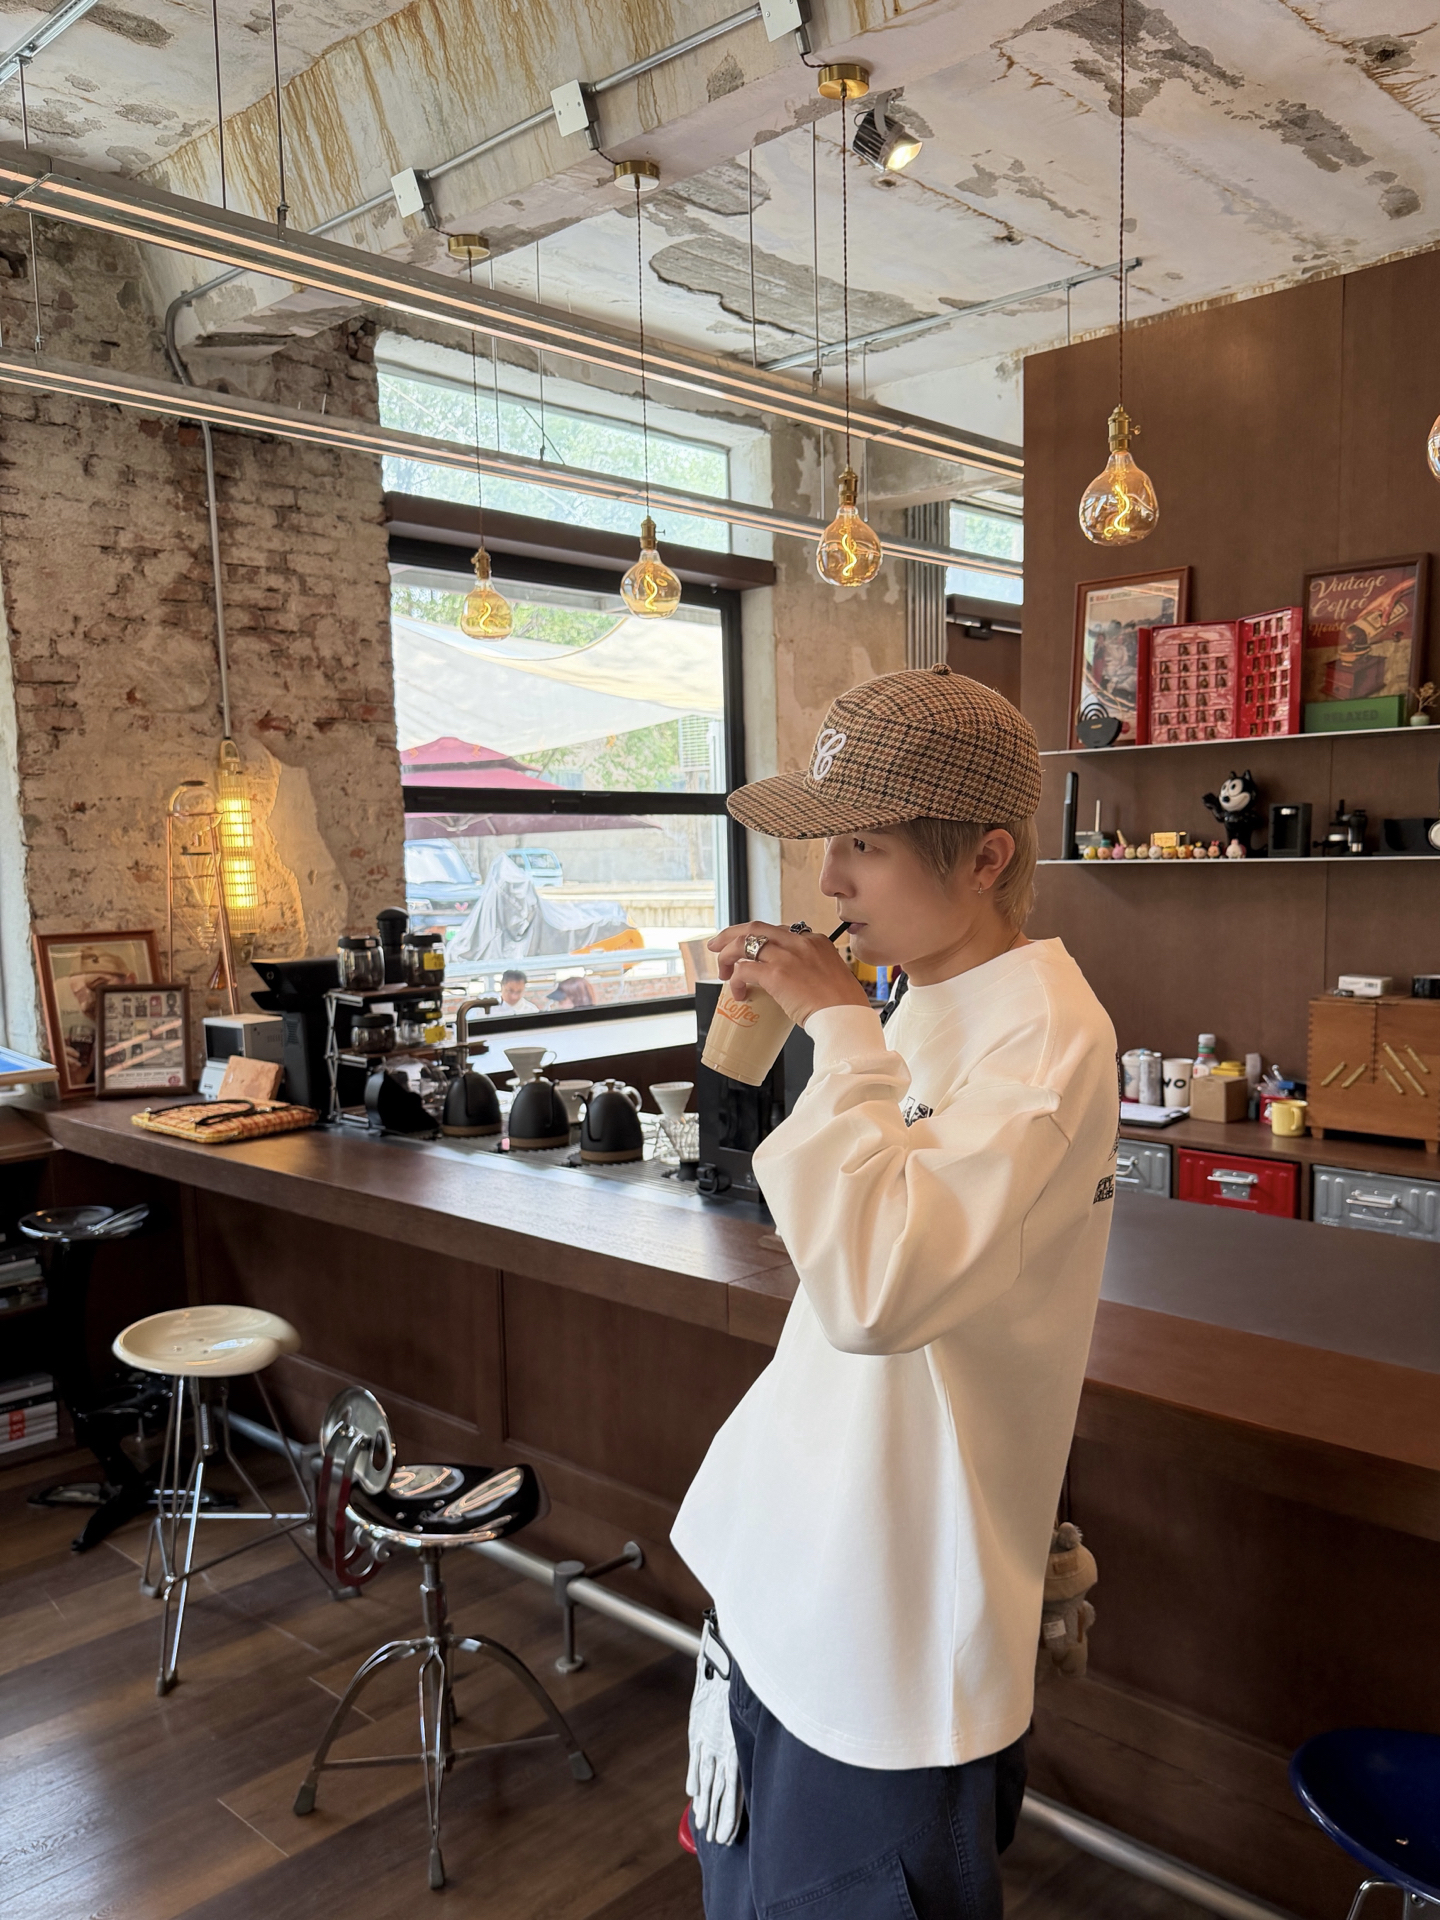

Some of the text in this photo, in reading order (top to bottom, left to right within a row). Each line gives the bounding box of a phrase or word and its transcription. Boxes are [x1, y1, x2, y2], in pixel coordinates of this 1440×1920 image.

[1310, 575, 1386, 598] Vintage
[1311, 598, 1367, 618] Coffee
[1310, 622, 1346, 637] House
[723, 997, 760, 1022] Coffee
